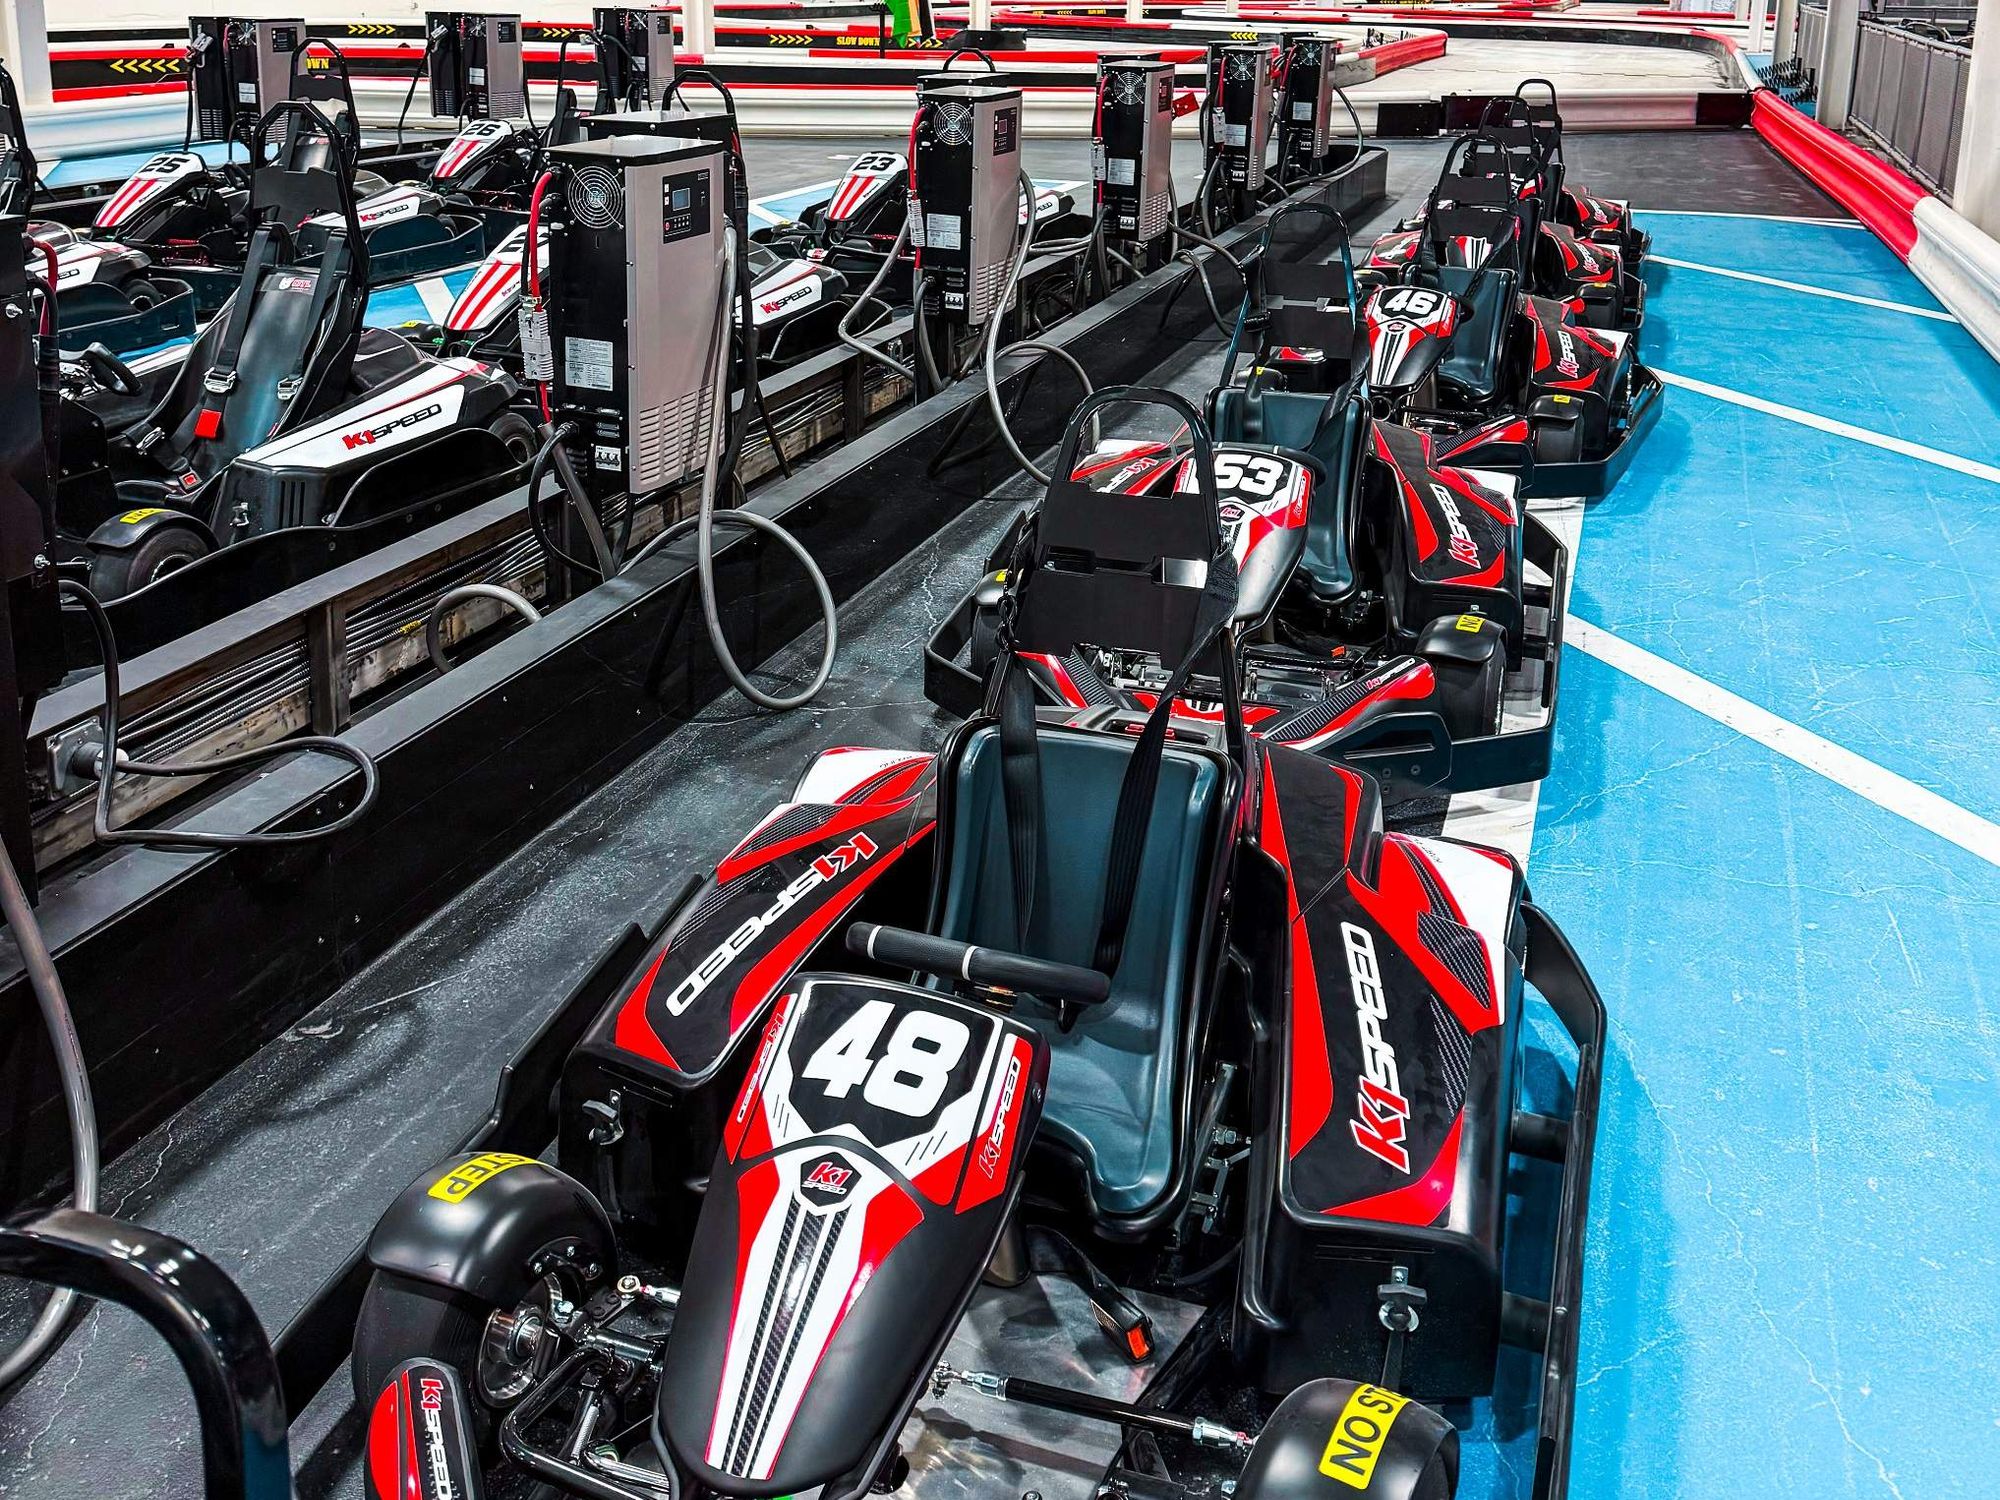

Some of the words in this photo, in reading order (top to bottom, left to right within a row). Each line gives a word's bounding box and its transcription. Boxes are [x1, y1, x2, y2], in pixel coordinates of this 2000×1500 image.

[837, 36, 856, 46] SLOW
[461, 123, 501, 136] 26
[139, 157, 191, 174] 25
[852, 156, 896, 171] 23
[1384, 289, 1438, 315] 46
[1214, 453, 1284, 496] 53
[801, 999, 971, 1118] 48
[446, 1154, 526, 1195] STEP
[807, 1161, 853, 1187] K1
[1329, 1415, 1382, 1476] NO
[1357, 1387, 1401, 1414] ST
